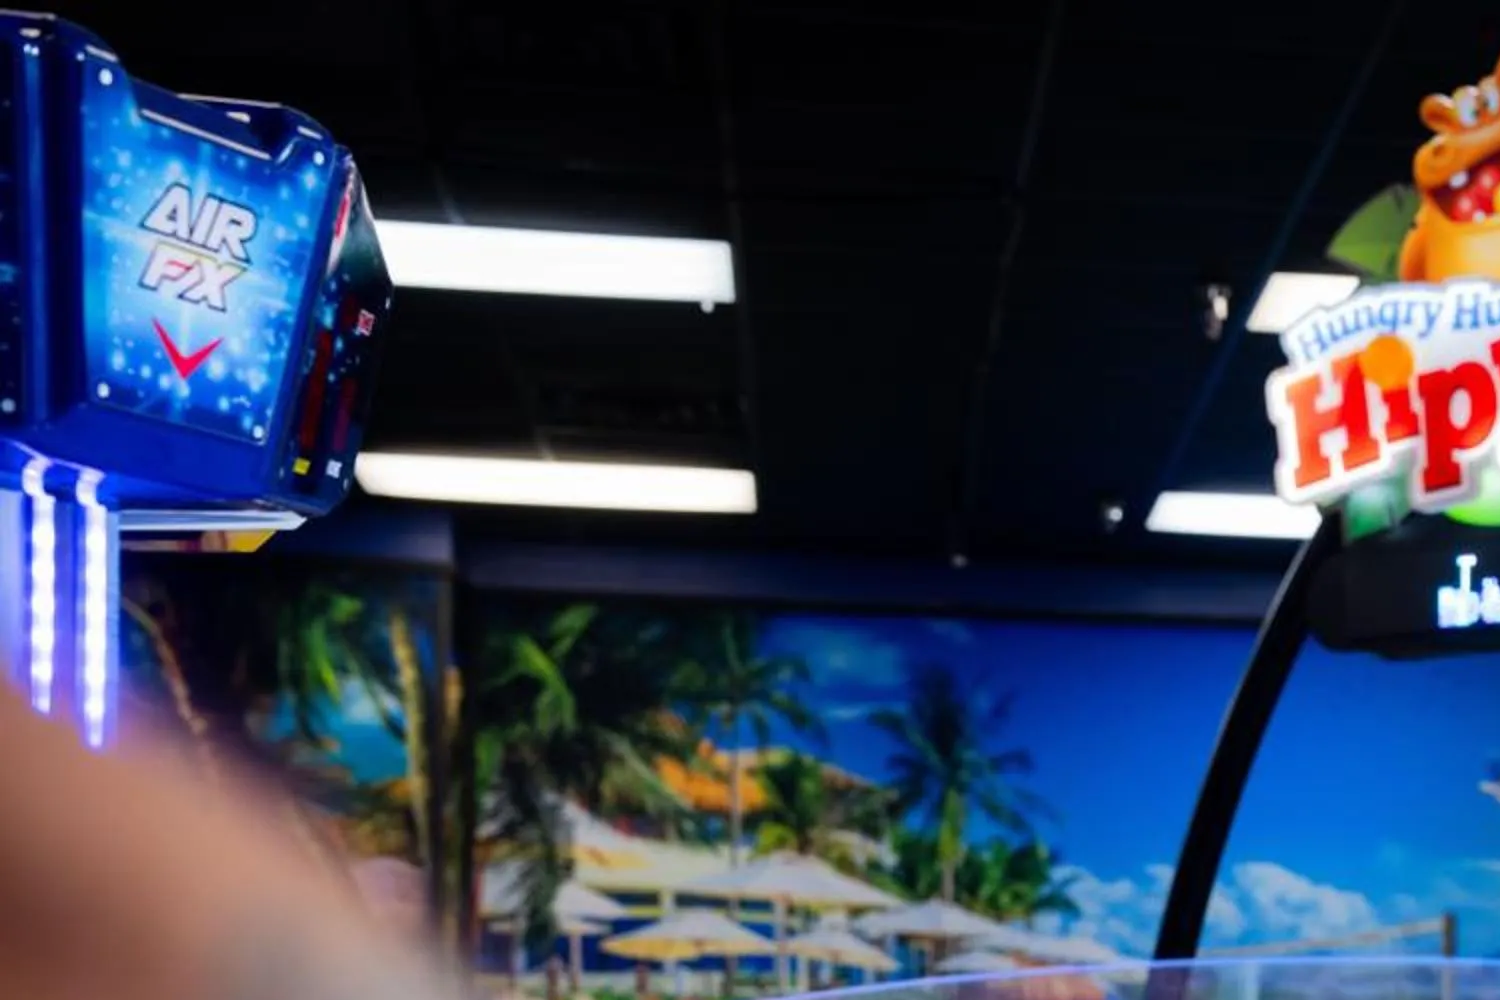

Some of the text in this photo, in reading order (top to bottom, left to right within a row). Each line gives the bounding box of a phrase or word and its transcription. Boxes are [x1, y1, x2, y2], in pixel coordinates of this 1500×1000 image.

[138, 181, 259, 265] AIR
[137, 239, 248, 313] FX
[1297, 298, 1443, 359] Hungry
